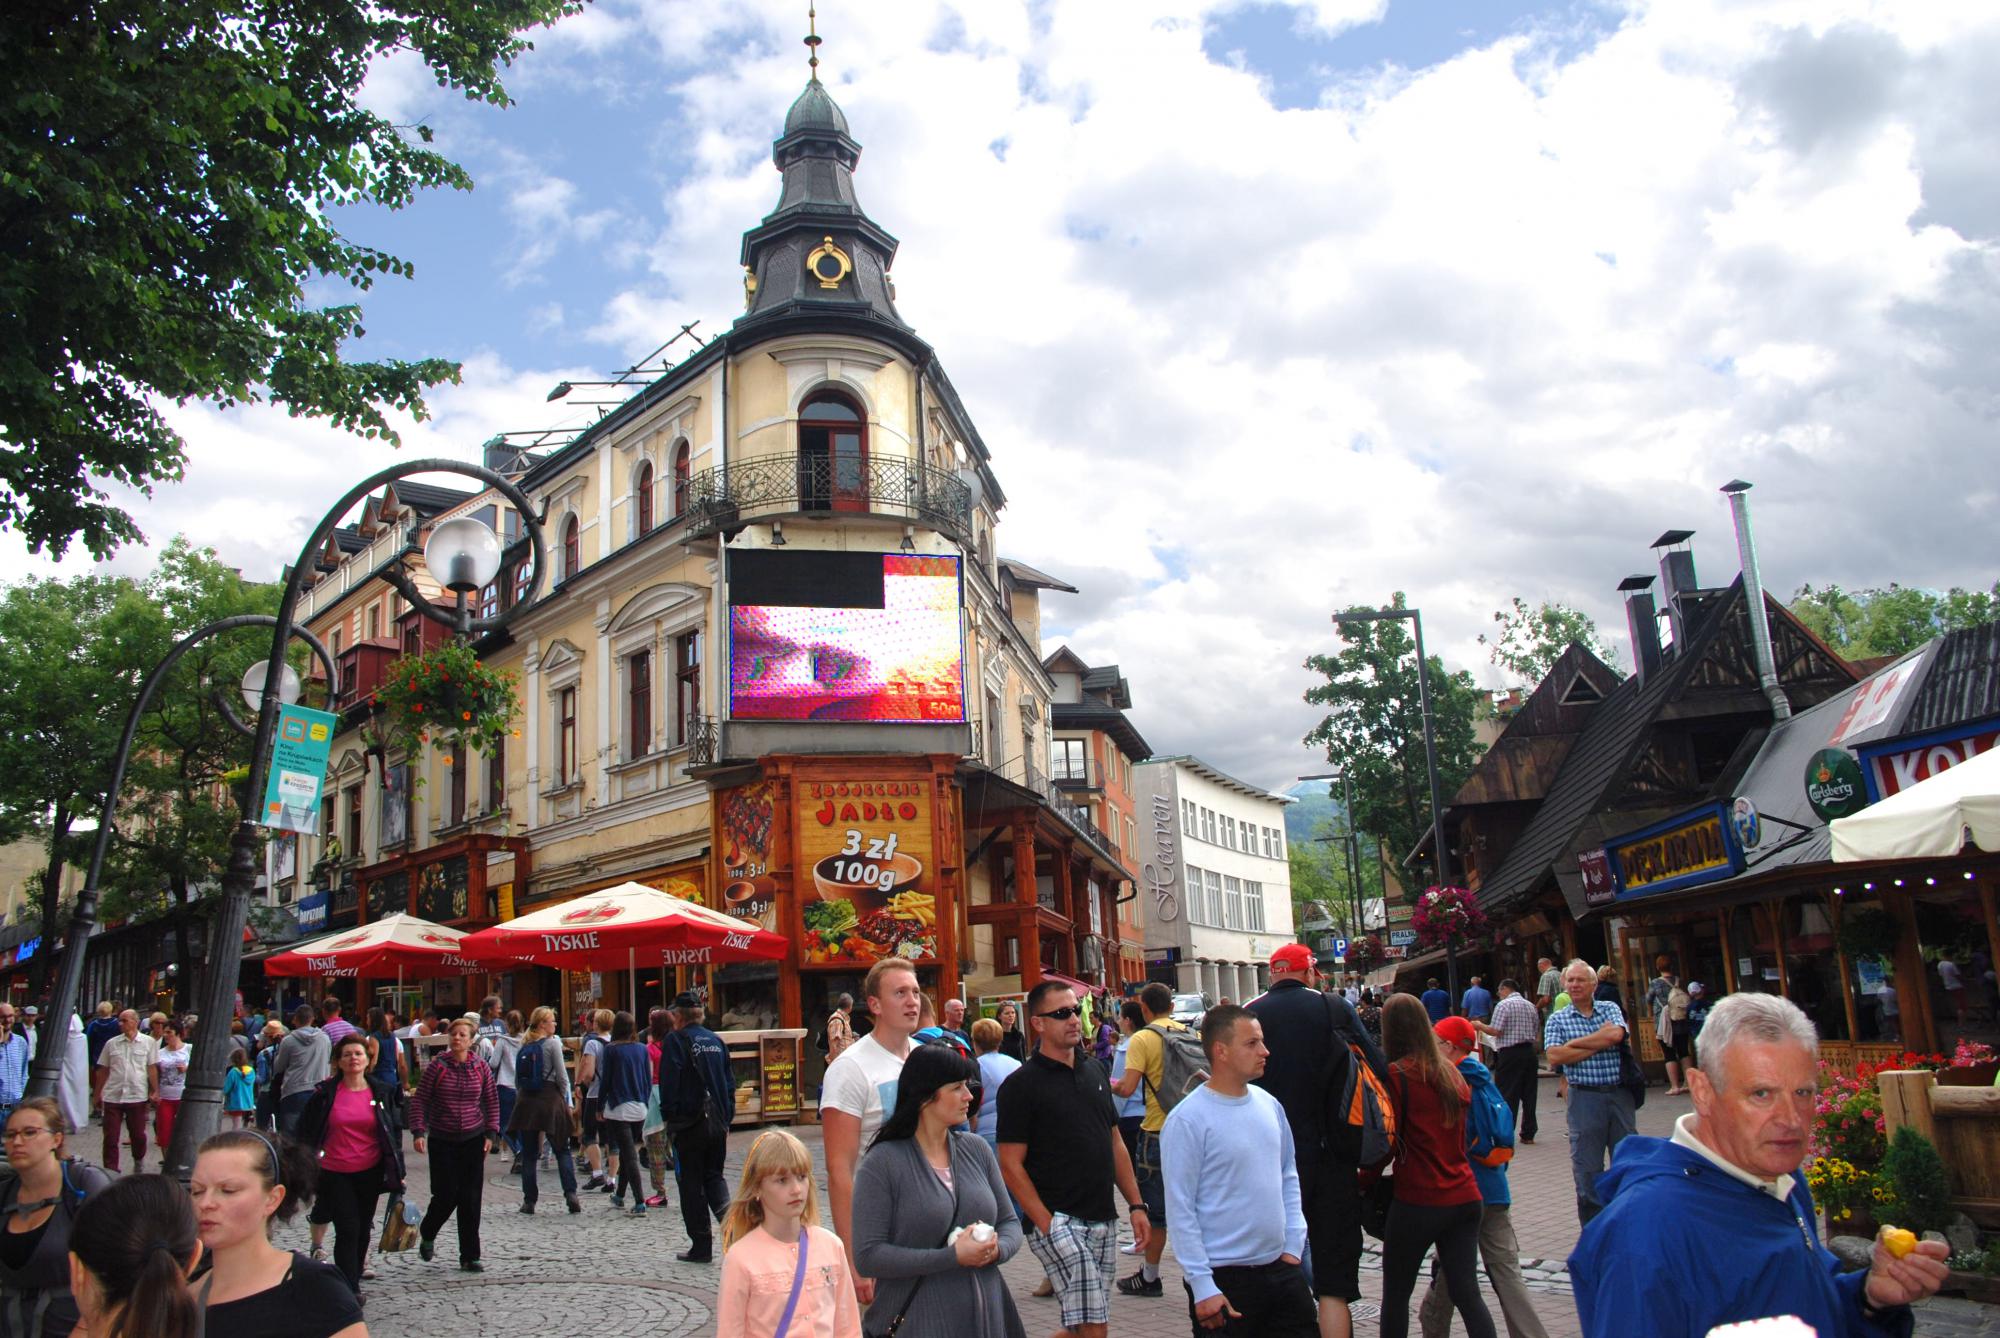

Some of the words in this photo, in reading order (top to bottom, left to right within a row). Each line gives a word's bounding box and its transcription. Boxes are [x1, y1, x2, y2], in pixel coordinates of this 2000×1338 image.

[810, 782, 921, 799] ZBÓJECKIE
[1808, 782, 1854, 805] Carlsberg
[815, 799, 918, 826] JADŁO
[841, 829, 862, 856] 3
[865, 832, 897, 861] zł
[1144, 793, 1179, 922] Heaven
[834, 860, 896, 892] 100g
[541, 931, 600, 952] TYSKIE
[721, 930, 756, 950] TYSKIE
[1336, 939, 1346, 952] P
[306, 955, 337, 971] TYSKIE
